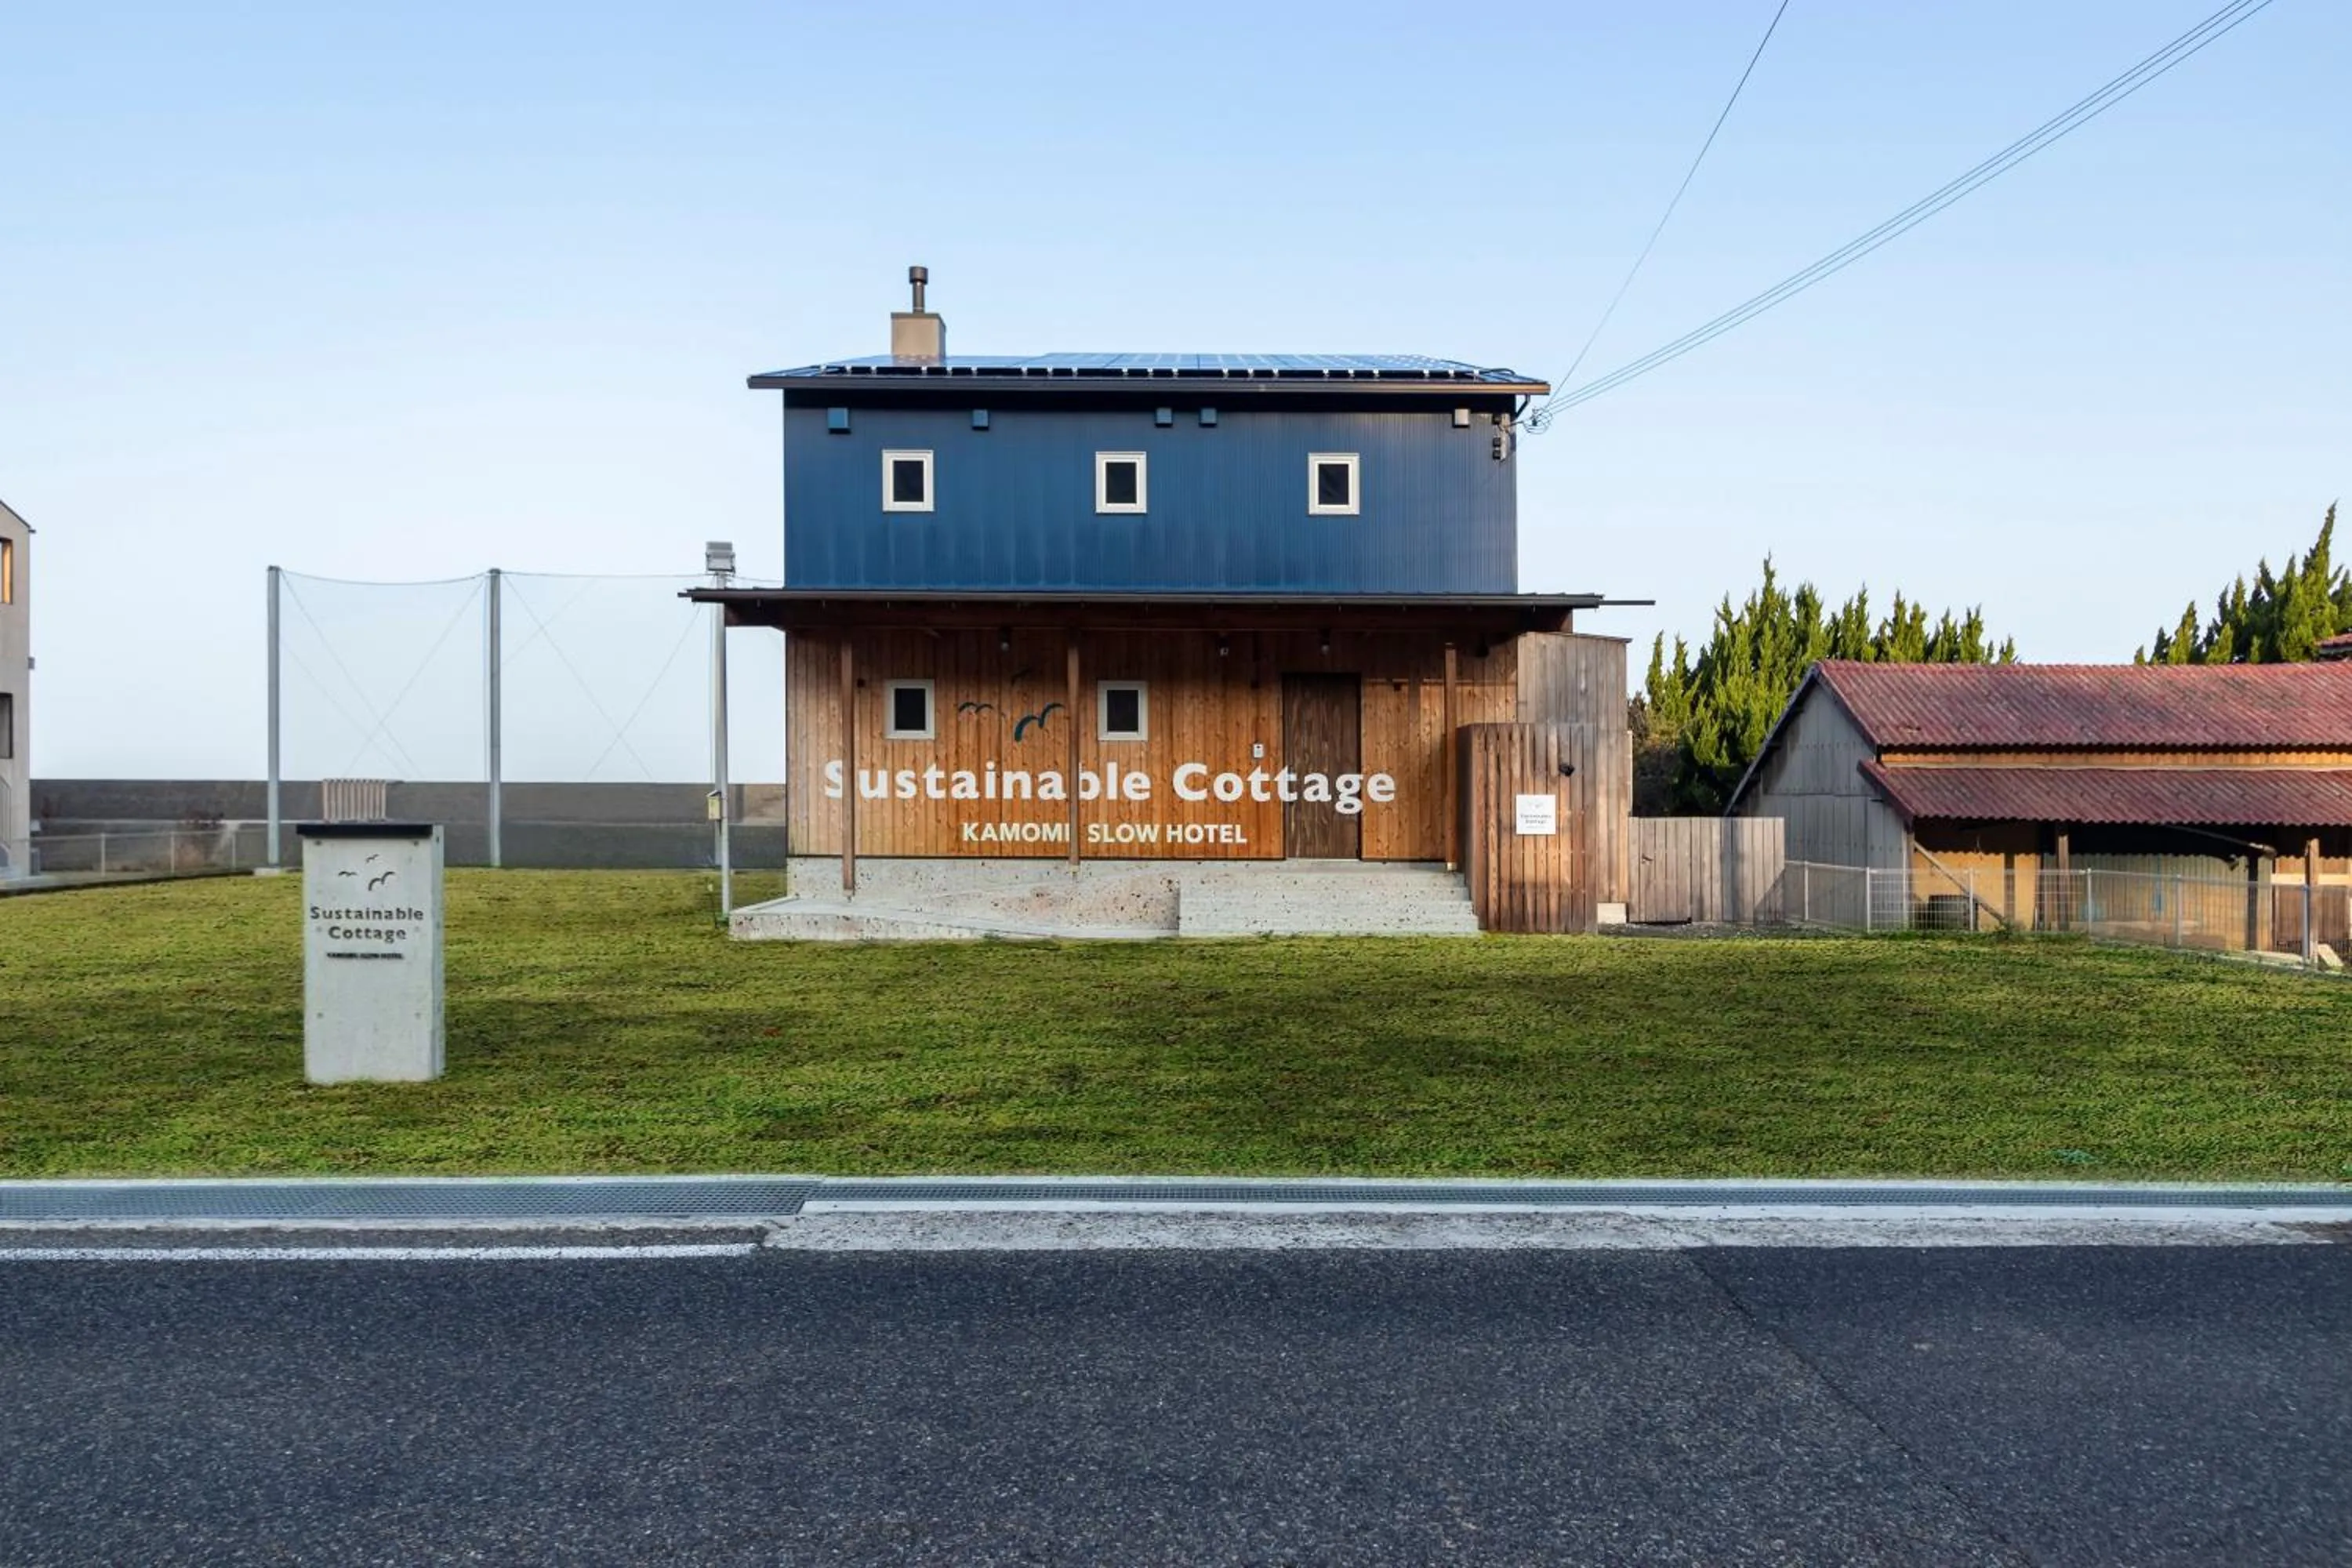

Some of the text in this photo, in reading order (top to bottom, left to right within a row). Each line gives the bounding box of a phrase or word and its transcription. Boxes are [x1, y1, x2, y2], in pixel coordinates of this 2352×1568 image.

[823, 759, 1395, 815] Sustainable Cottage
[1087, 822, 1160, 843] SLOW
[1166, 824, 1247, 844] HOTEL
[310, 906, 424, 921] Sustainable
[328, 925, 407, 945] Cottage
